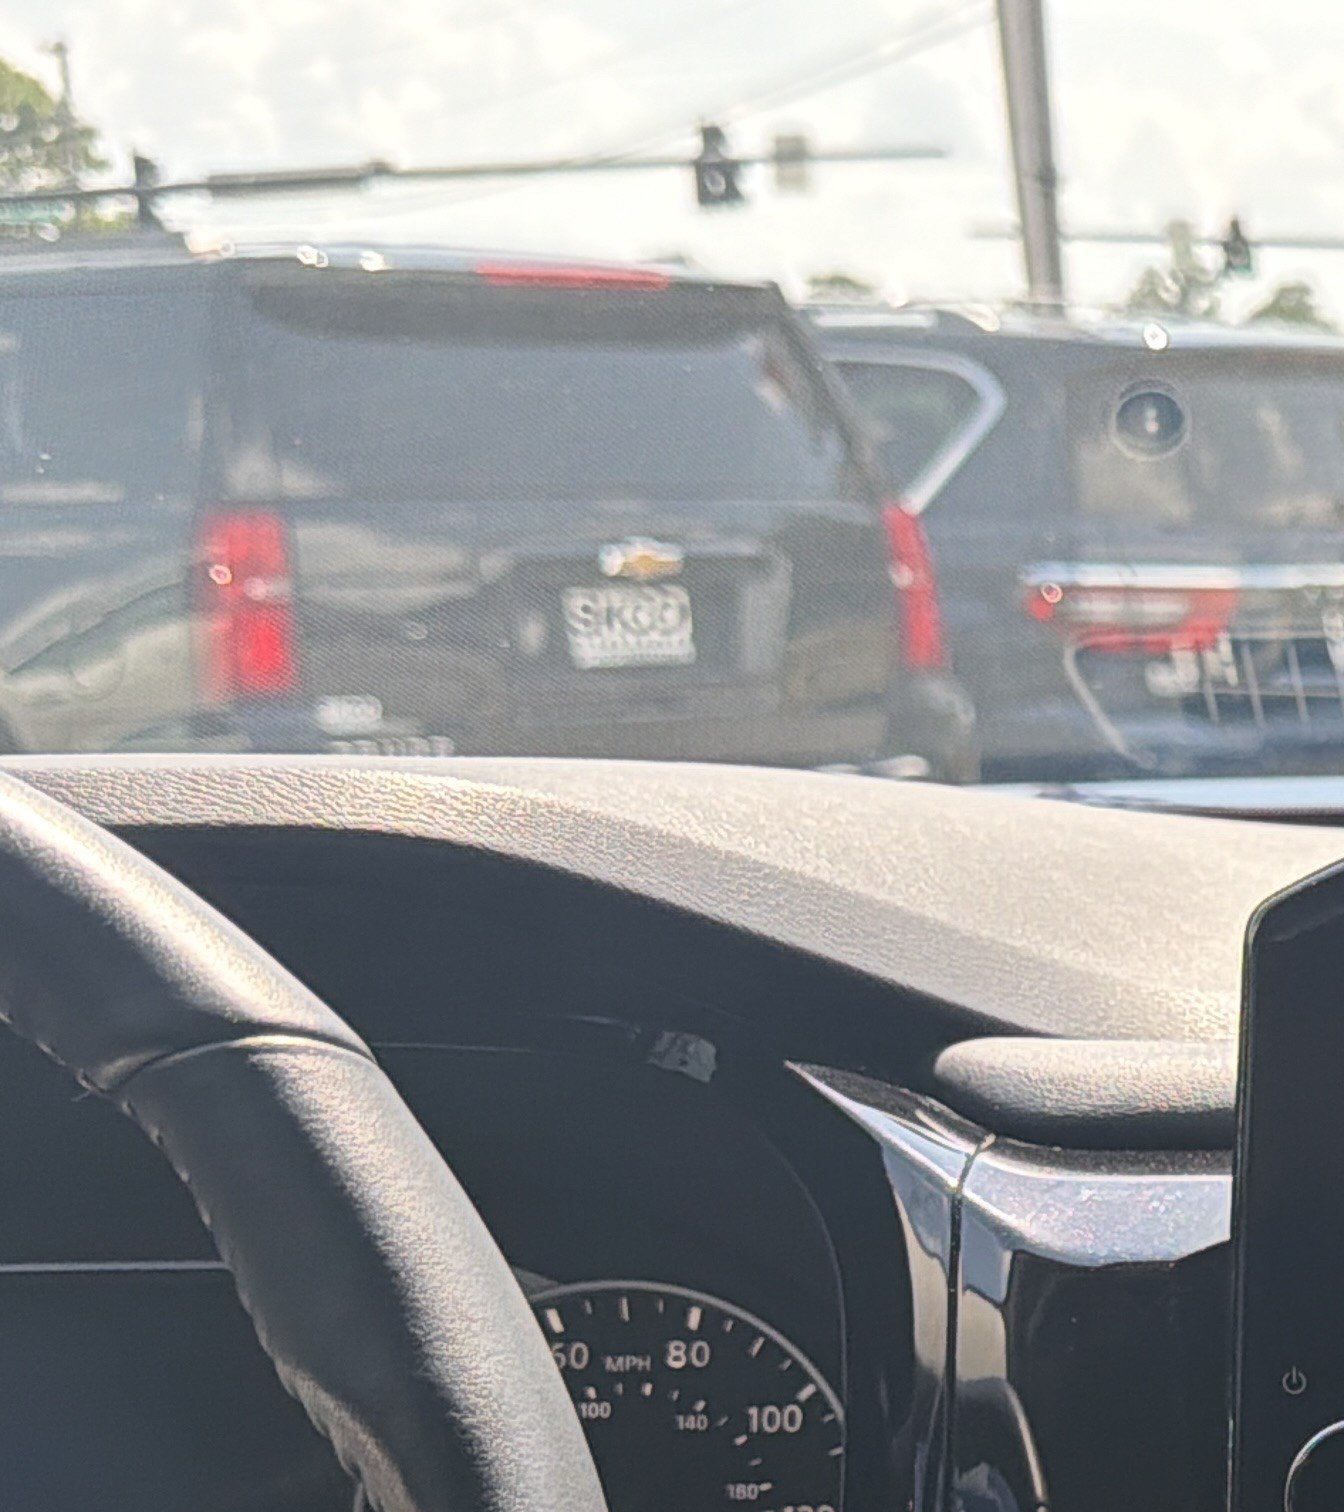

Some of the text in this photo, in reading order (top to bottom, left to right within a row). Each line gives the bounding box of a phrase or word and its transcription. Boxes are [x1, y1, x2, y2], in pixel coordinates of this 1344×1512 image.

[604, 1354, 652, 1373] MPH
[665, 1340, 711, 1370] 80
[580, 1402, 612, 1419] 100
[747, 1405, 803, 1434] 100
[676, 1414, 709, 1431] 140
